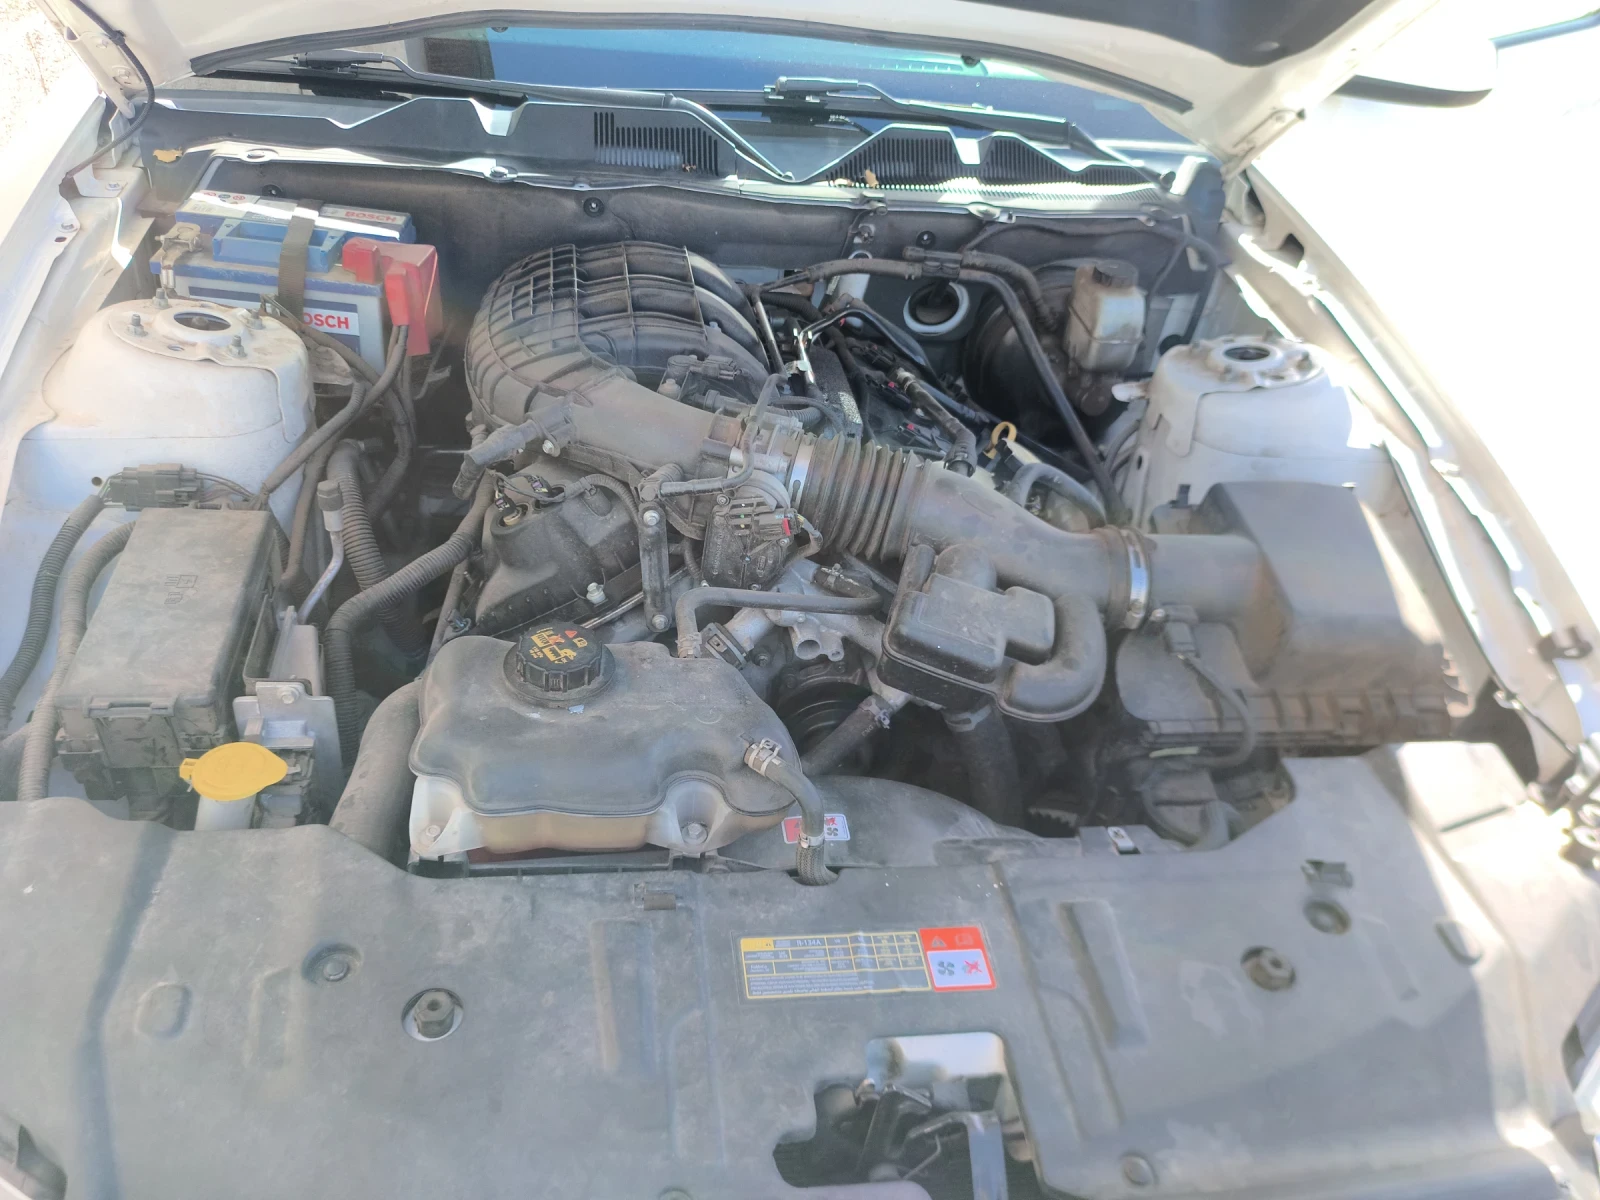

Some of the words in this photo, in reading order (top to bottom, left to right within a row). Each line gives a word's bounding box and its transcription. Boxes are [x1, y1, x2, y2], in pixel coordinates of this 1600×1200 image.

[344, 211, 397, 222] BOSCH
[303, 312, 350, 329] OSCH
[796, 939, 822, 947] R-134A
